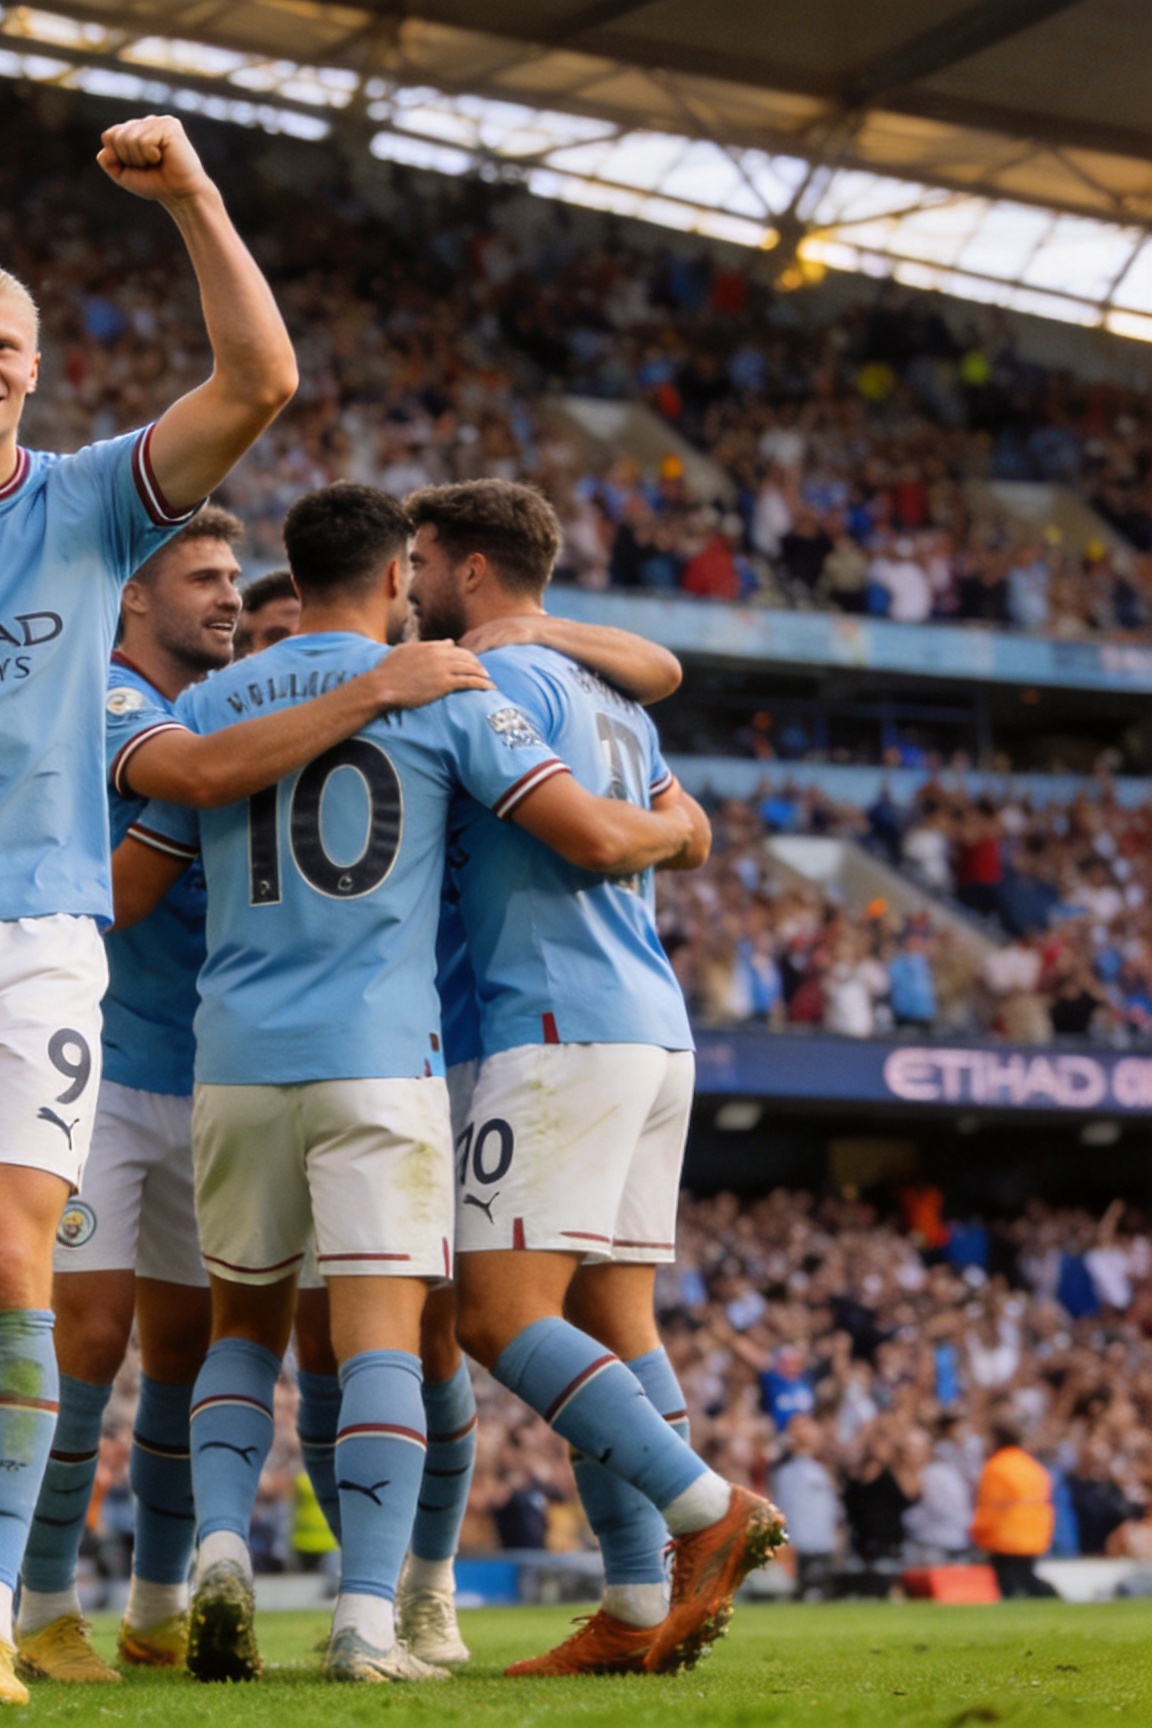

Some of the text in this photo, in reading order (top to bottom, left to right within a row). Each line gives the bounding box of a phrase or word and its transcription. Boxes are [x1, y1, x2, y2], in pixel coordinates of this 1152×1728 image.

[249, 736, 404, 907] 10
[47, 1028, 91, 1105] 9
[883, 1046, 1107, 1109] ETIHAD
[456, 1117, 515, 1186] 10
